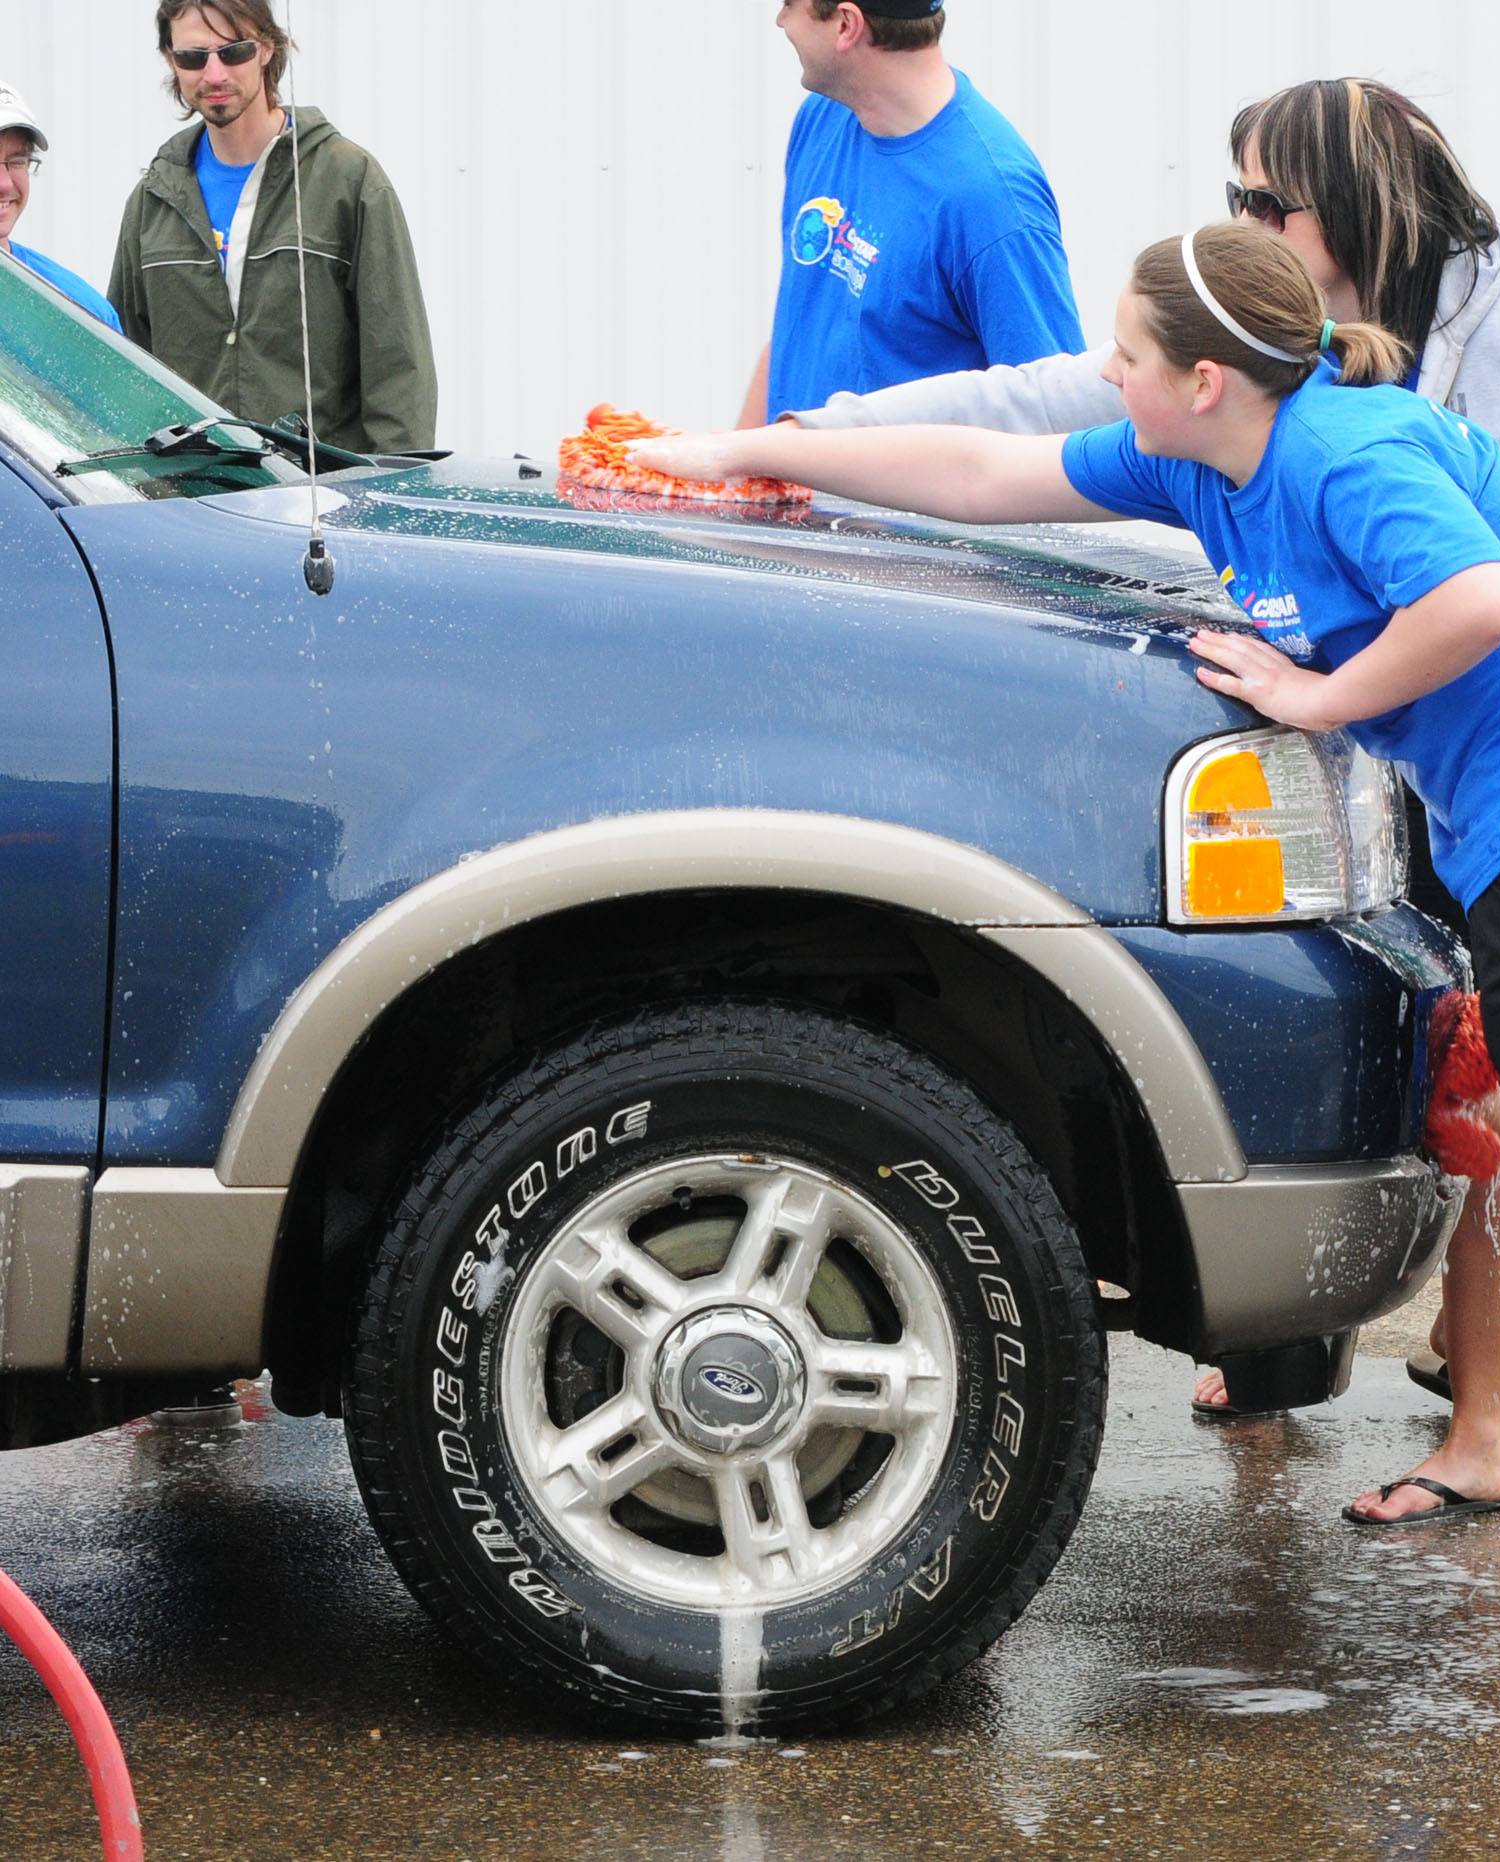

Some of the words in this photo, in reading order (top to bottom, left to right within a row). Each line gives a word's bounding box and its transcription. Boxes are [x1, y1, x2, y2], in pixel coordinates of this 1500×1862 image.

[432, 1101, 652, 1617] BRIDGESTONE
[713, 1372, 749, 1395] Ford
[891, 1160, 1025, 1522] DUELER
